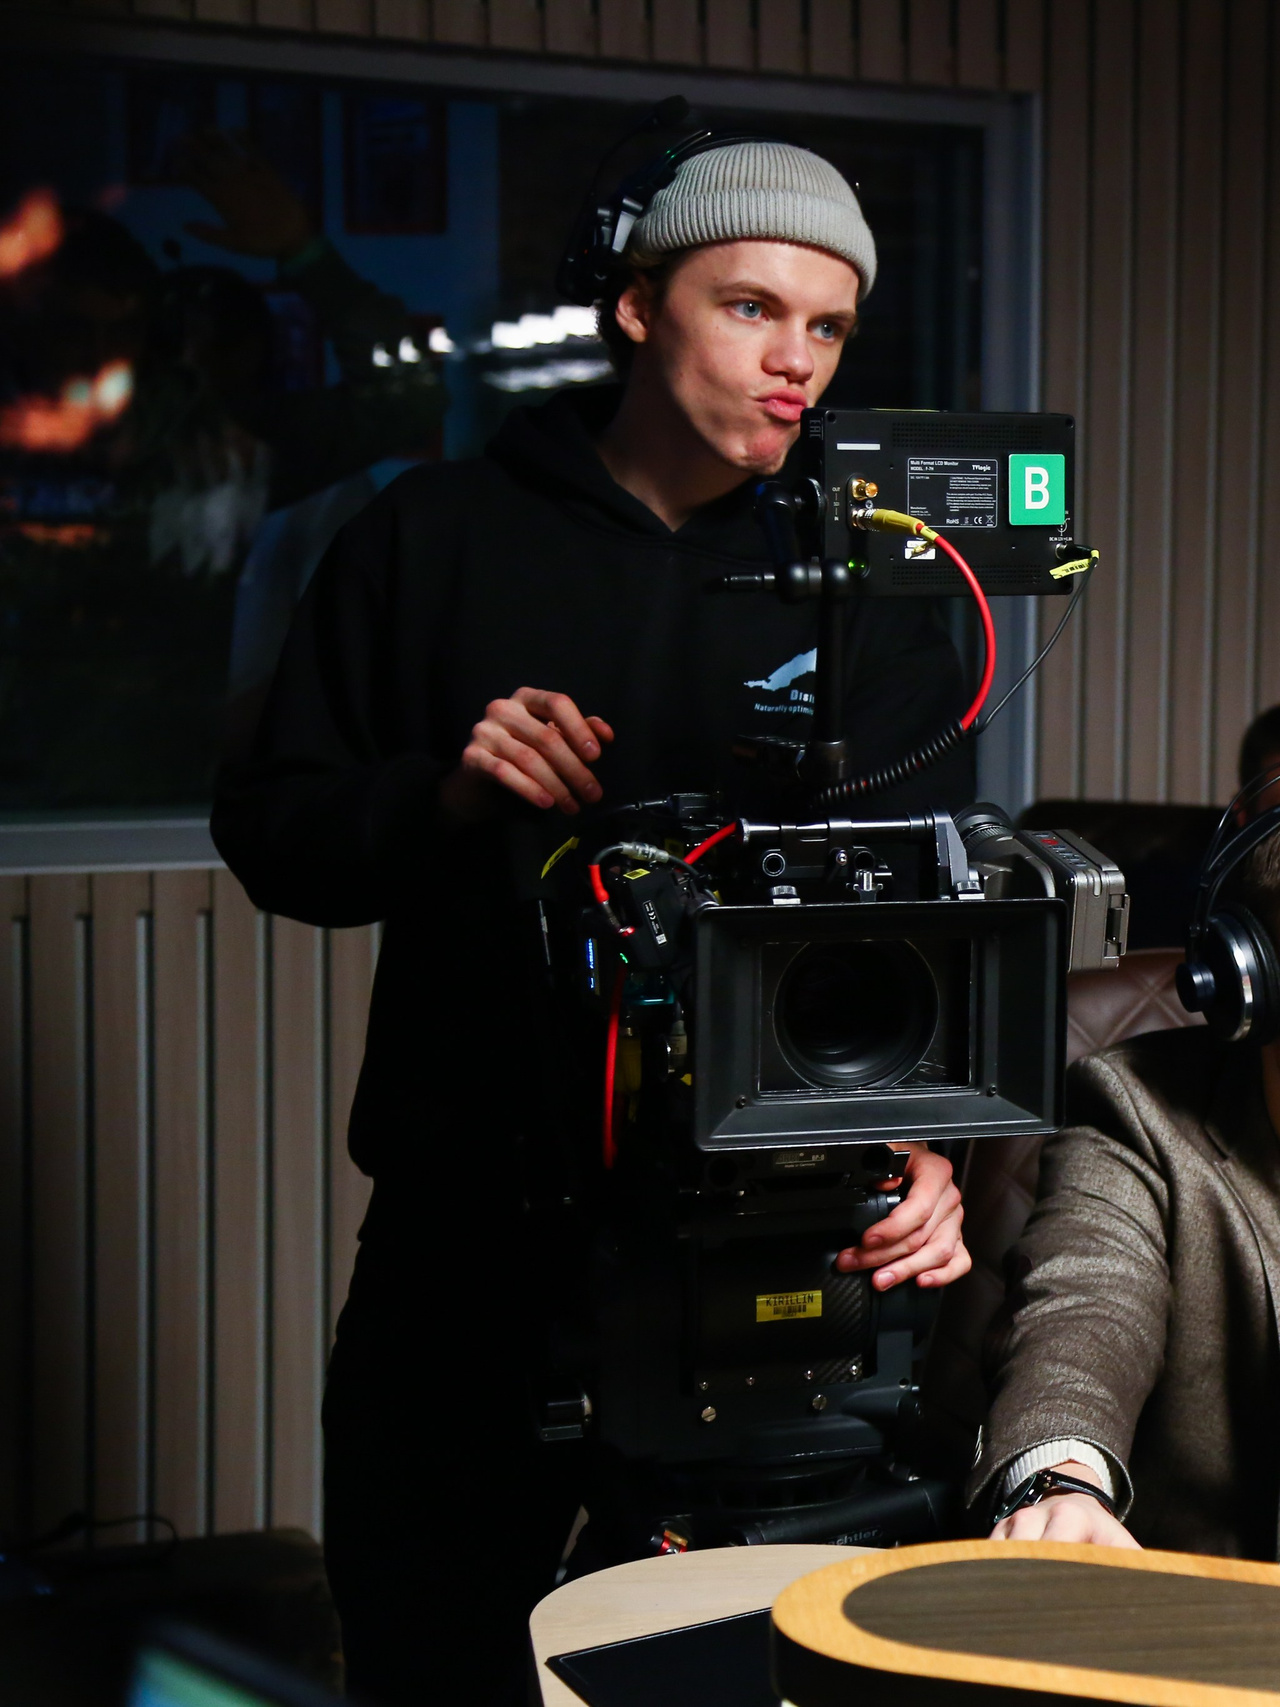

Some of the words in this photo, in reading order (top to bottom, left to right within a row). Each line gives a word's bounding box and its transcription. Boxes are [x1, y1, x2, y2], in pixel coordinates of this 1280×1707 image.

[1024, 466, 1050, 510] B
[754, 703, 788, 713] Naturally
[766, 1293, 814, 1306] KIRILLIN
